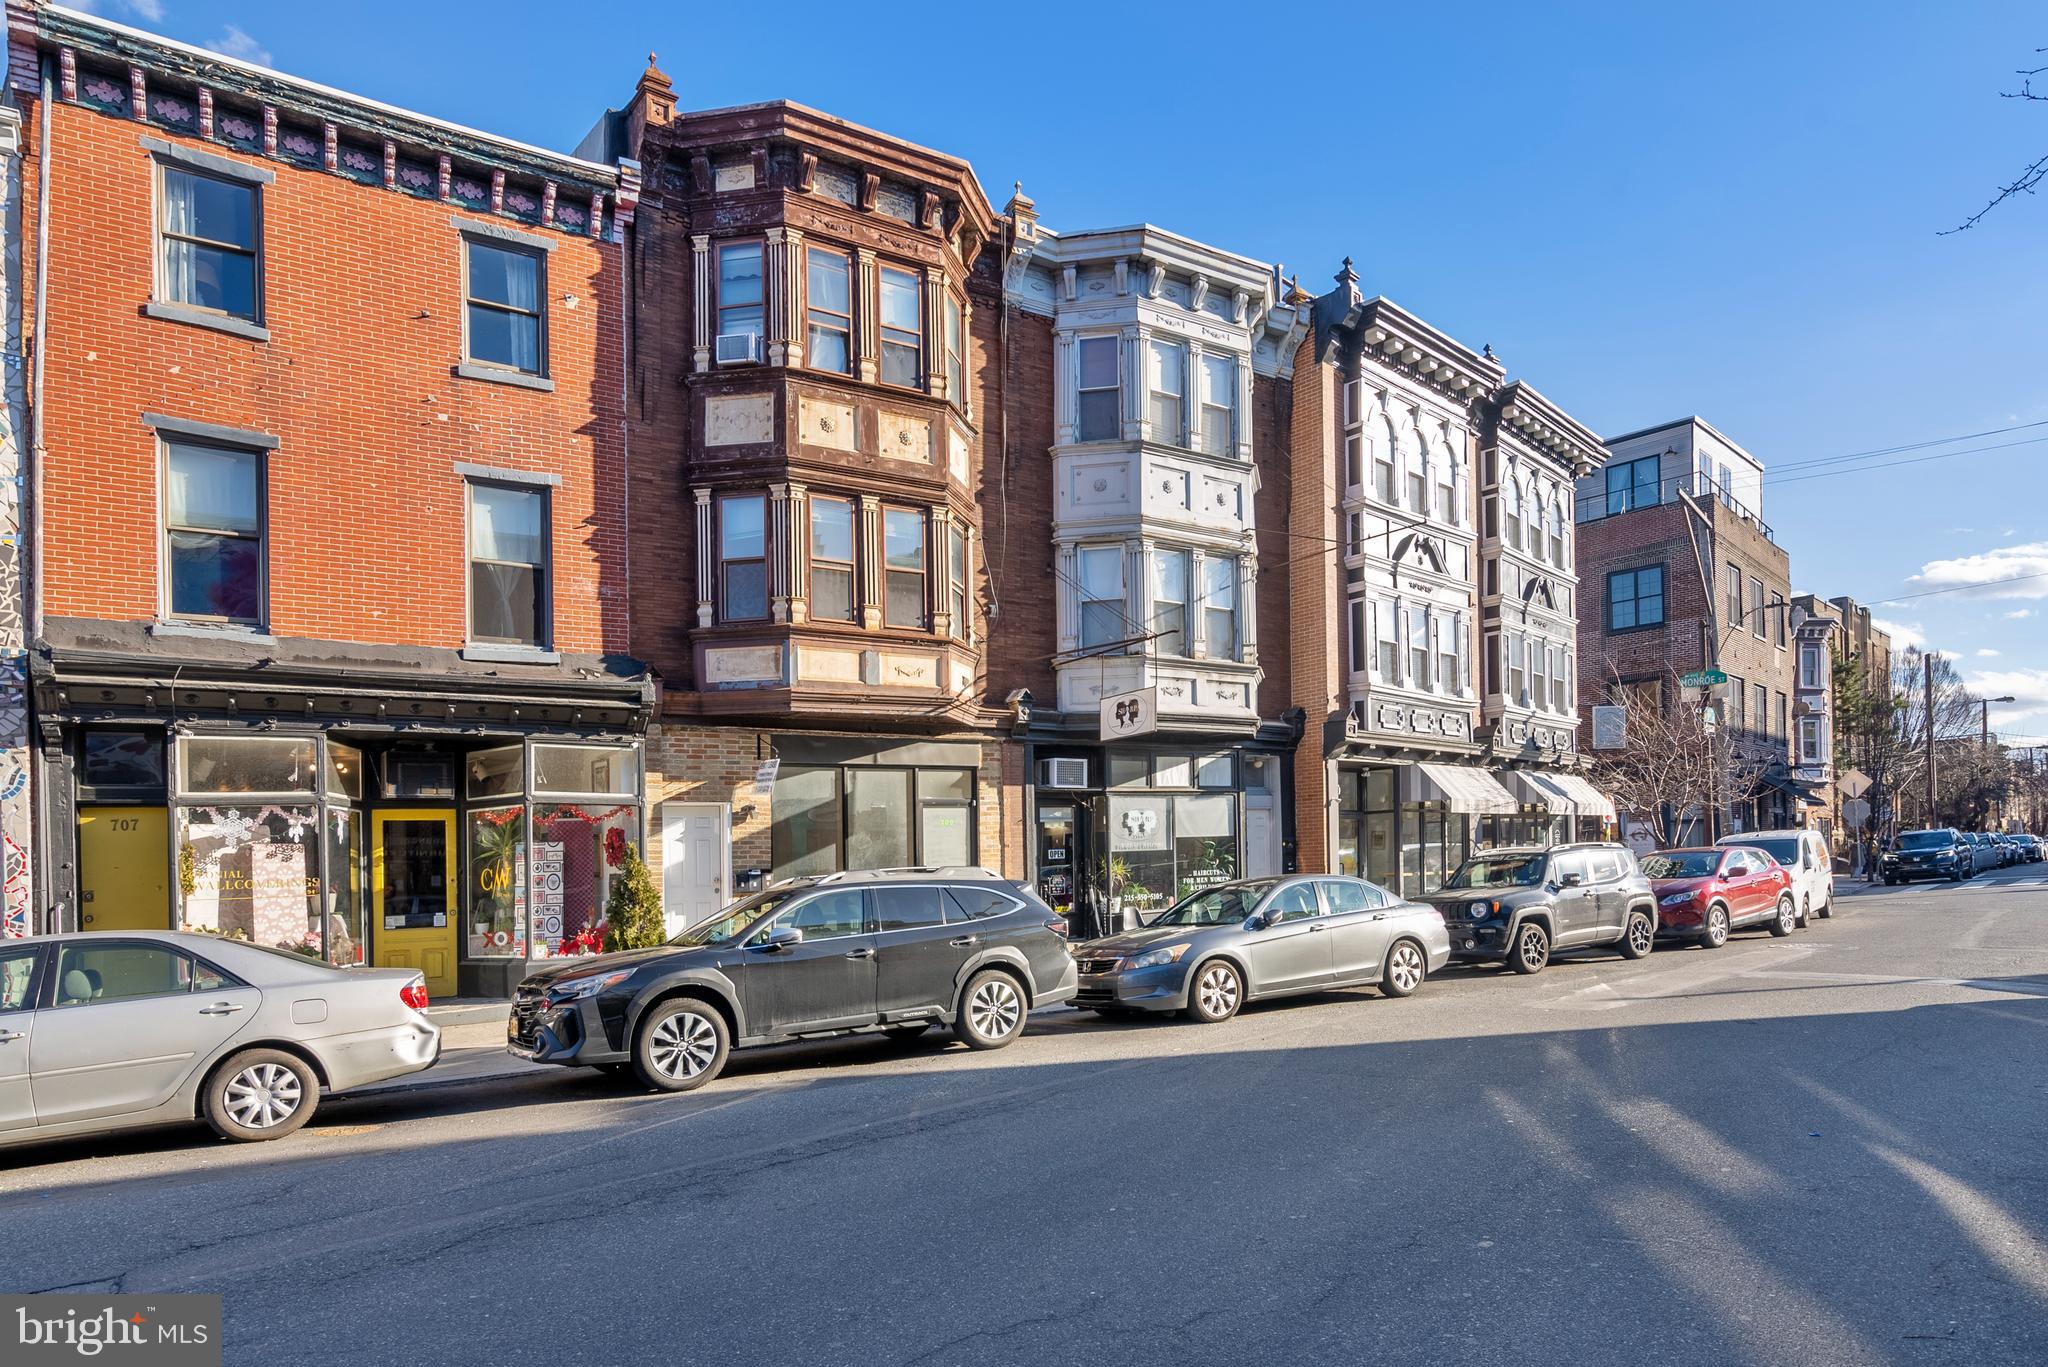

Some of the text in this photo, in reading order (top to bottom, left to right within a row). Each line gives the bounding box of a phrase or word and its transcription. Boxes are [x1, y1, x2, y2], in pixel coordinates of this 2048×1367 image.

[1681, 675, 1716, 687] MONROE
[110, 819, 139, 831] 707
[1124, 893, 1163, 901] 215-550-5105
